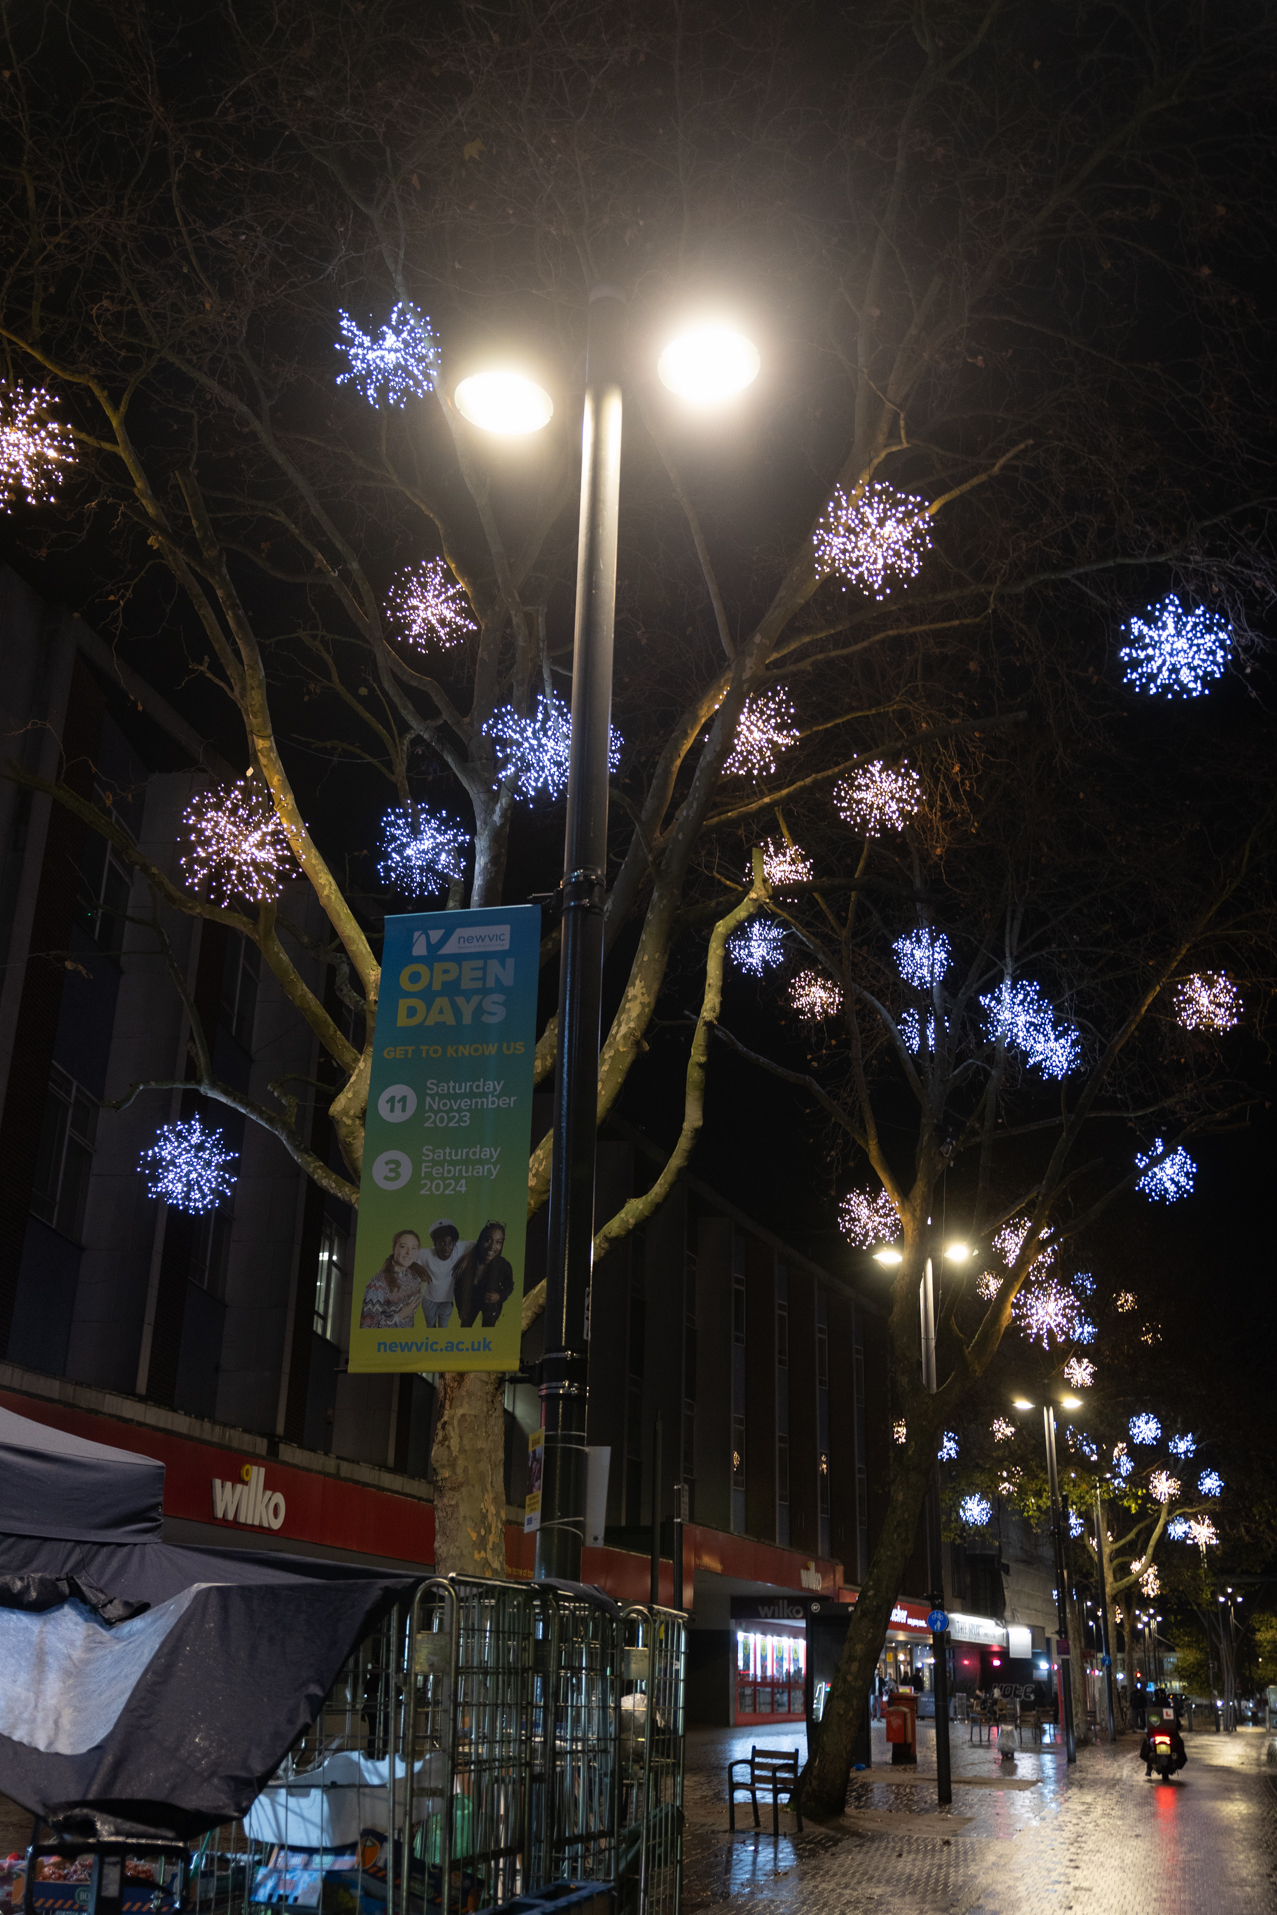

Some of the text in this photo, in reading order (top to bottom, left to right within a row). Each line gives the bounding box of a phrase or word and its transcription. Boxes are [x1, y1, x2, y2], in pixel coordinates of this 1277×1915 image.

[399, 957, 515, 992] OPEN
[396, 994, 507, 1027] DAYS
[383, 1041, 525, 1059] GET TO KNOW US
[426, 1079, 505, 1095] Saturday
[385, 1095, 408, 1114] 11
[425, 1094, 517, 1111] November
[423, 1112, 471, 1127] 2023
[422, 1144, 501, 1162] Saturday
[382, 1158, 402, 1182] 3
[421, 1162, 500, 1179] February
[419, 1179, 467, 1195] 2024
[377, 1337, 493, 1353] newvic.ac.uk
[211, 1463, 286, 1530] wilko
[801, 1560, 822, 1591] wilko
[757, 1599, 804, 1618] wilko
